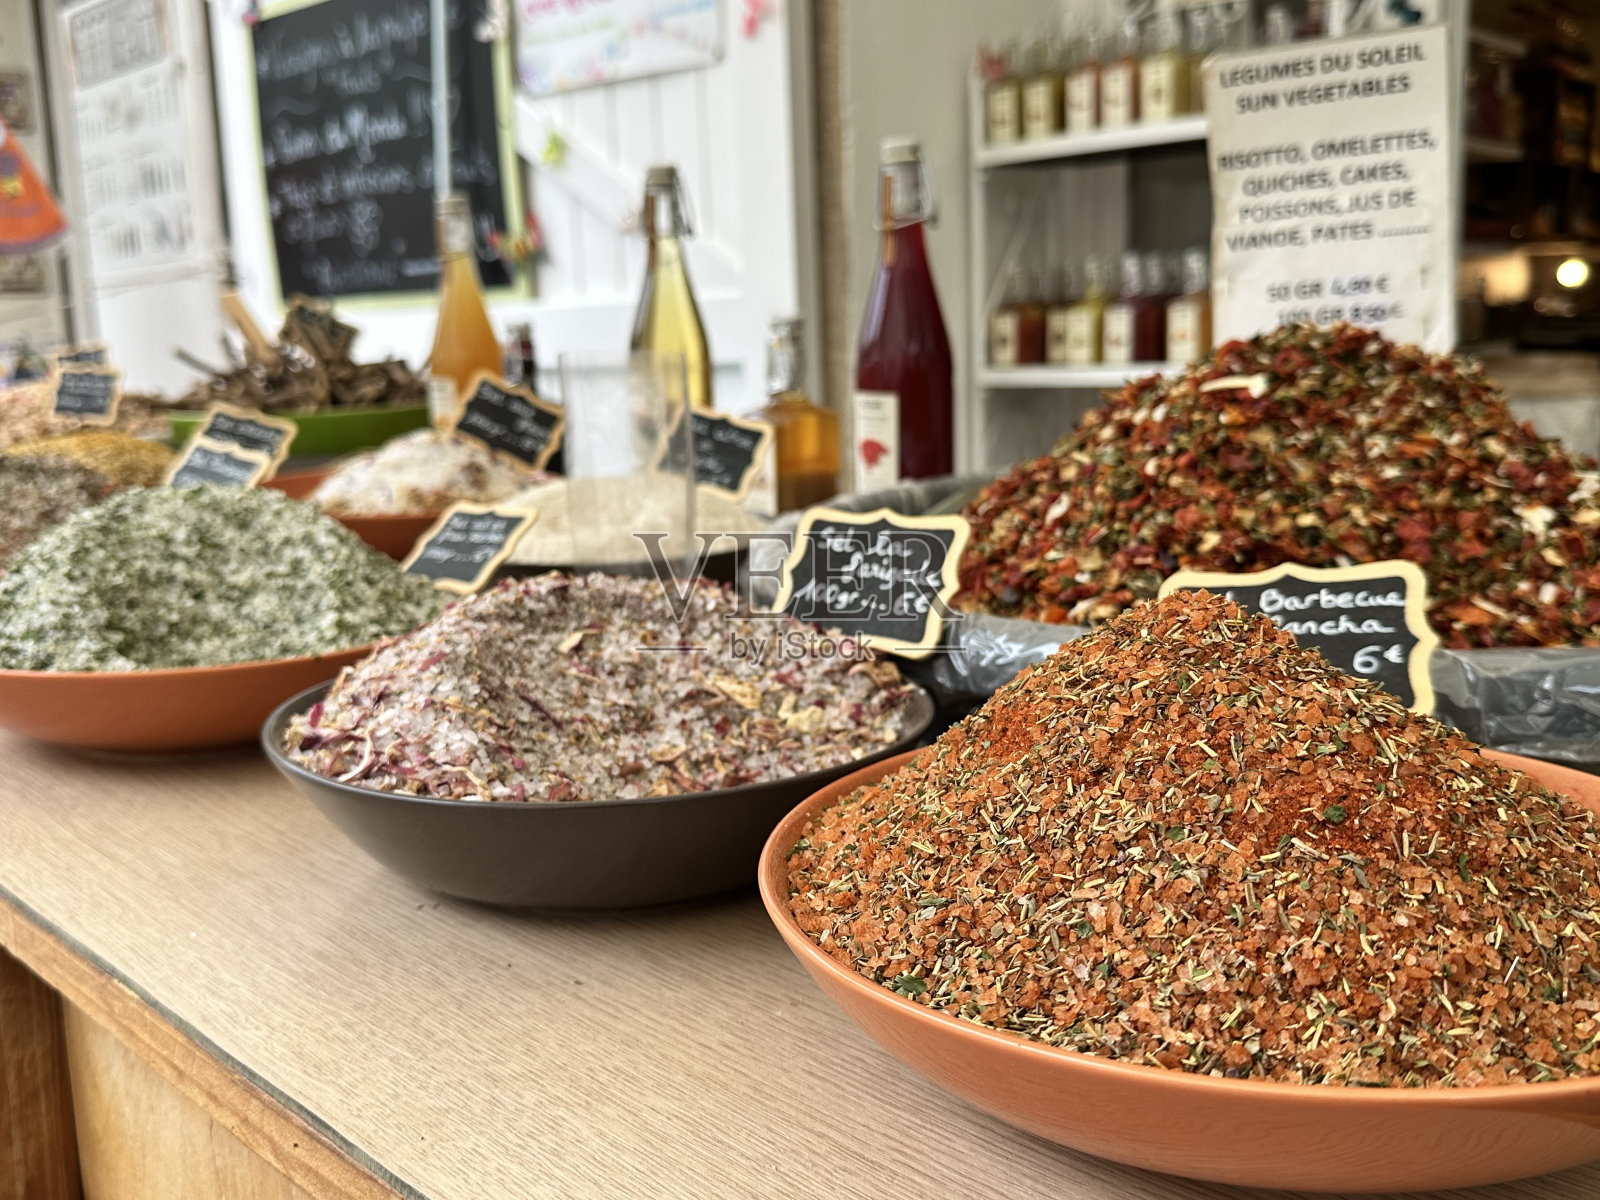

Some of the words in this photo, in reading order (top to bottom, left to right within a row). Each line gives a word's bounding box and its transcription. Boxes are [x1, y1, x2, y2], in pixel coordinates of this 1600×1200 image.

[1219, 57, 1316, 88] LEGUMES
[1320, 53, 1351, 75] DU
[1356, 43, 1426, 70] SOLEIL
[1236, 92, 1279, 115] SUN
[1284, 74, 1411, 107] VEGETABLES
[1217, 145, 1306, 173] RISOTTO,
[1311, 130, 1438, 161] OMELETTES,
[1242, 170, 1334, 198] QUICHES,
[1339, 162, 1410, 187] CAKES,
[1239, 197, 1343, 224] POISSONS,
[1348, 193, 1383, 213] JUS
[1388, 189, 1417, 209] DE
[1226, 229, 1306, 252] VIANDE,
[1312, 221, 1375, 243] PATES
[1293, 280, 1324, 300] GR
[1260, 588, 1406, 613] Barbecue
[1353, 644, 1404, 674] 6€
